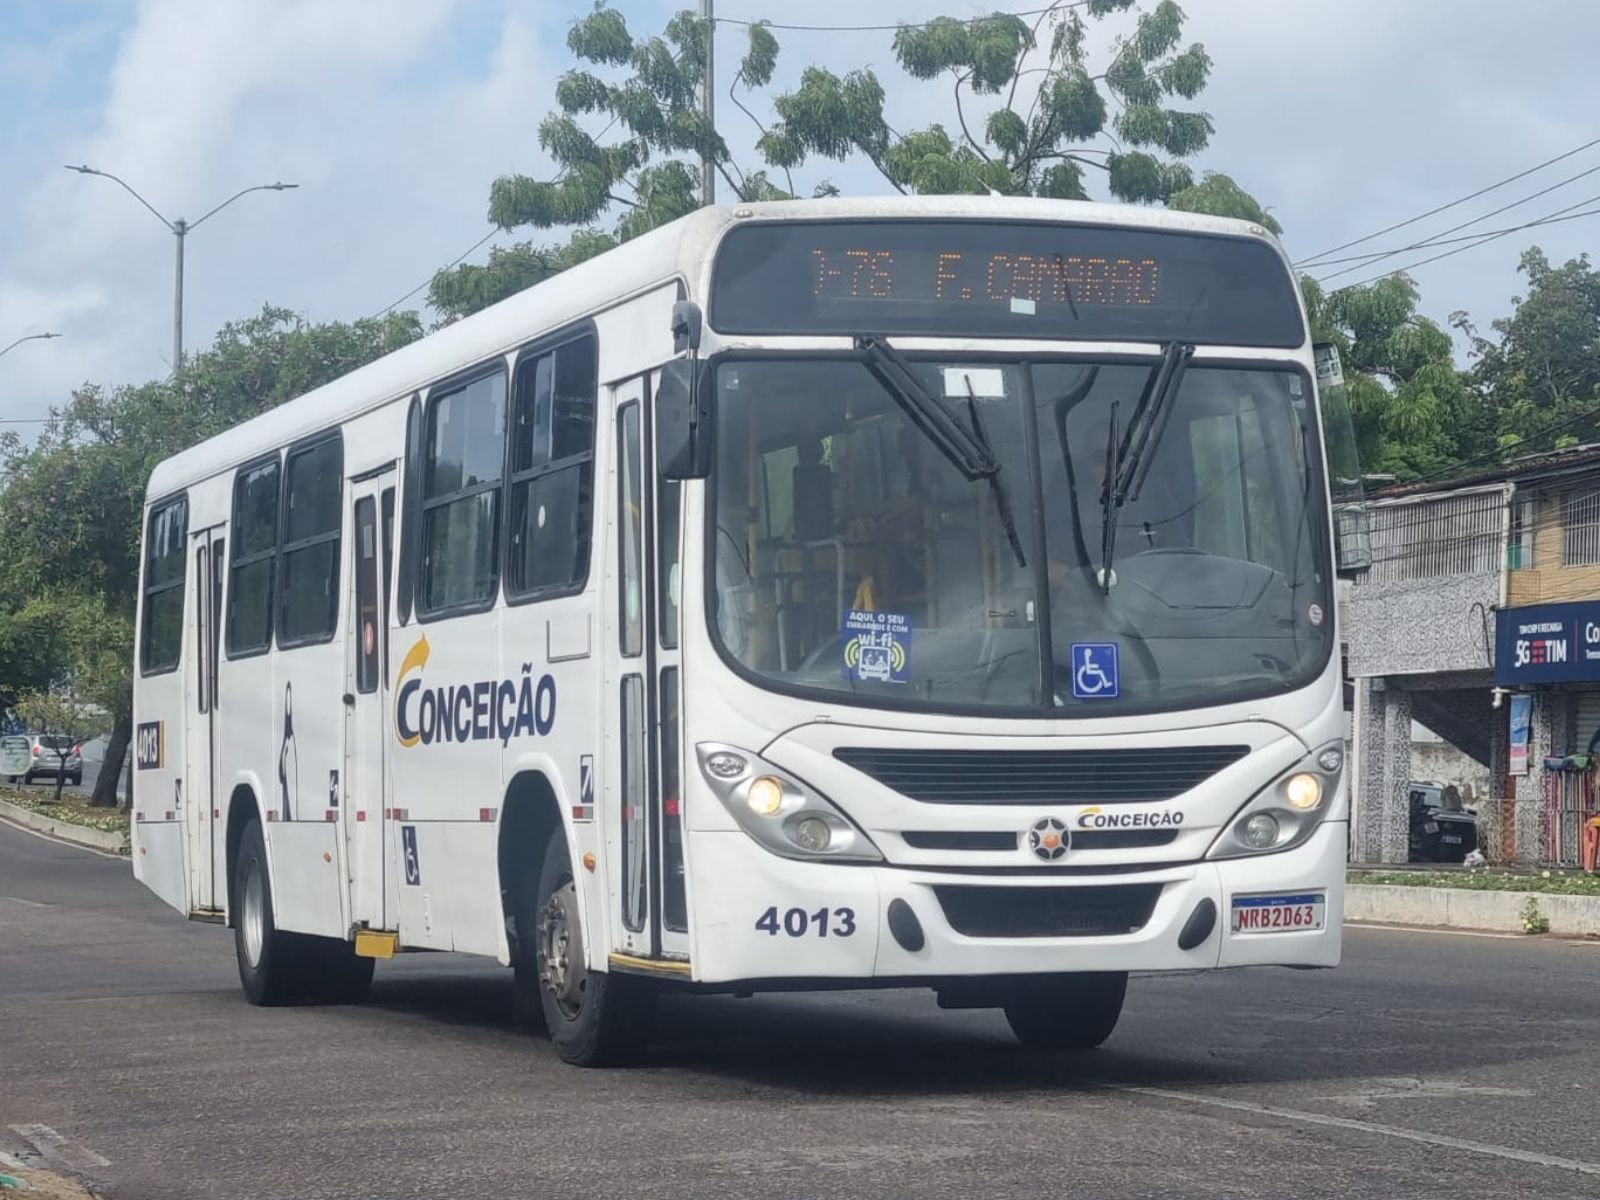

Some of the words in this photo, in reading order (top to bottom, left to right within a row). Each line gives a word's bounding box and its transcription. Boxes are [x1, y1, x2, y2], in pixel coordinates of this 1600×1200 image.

[849, 611, 876, 624] AQUI,
[877, 614, 885, 622] O
[887, 614, 904, 624] SEU
[858, 631, 893, 647] wi-fi
[1514, 639, 1530, 668] 5G
[1544, 639, 1567, 662] TIM
[397, 661, 556, 748] CONCEIÇÃO
[138, 726, 158, 763] 4013
[755, 906, 856, 937] 4013
[1238, 905, 1314, 928] NRB2D63
